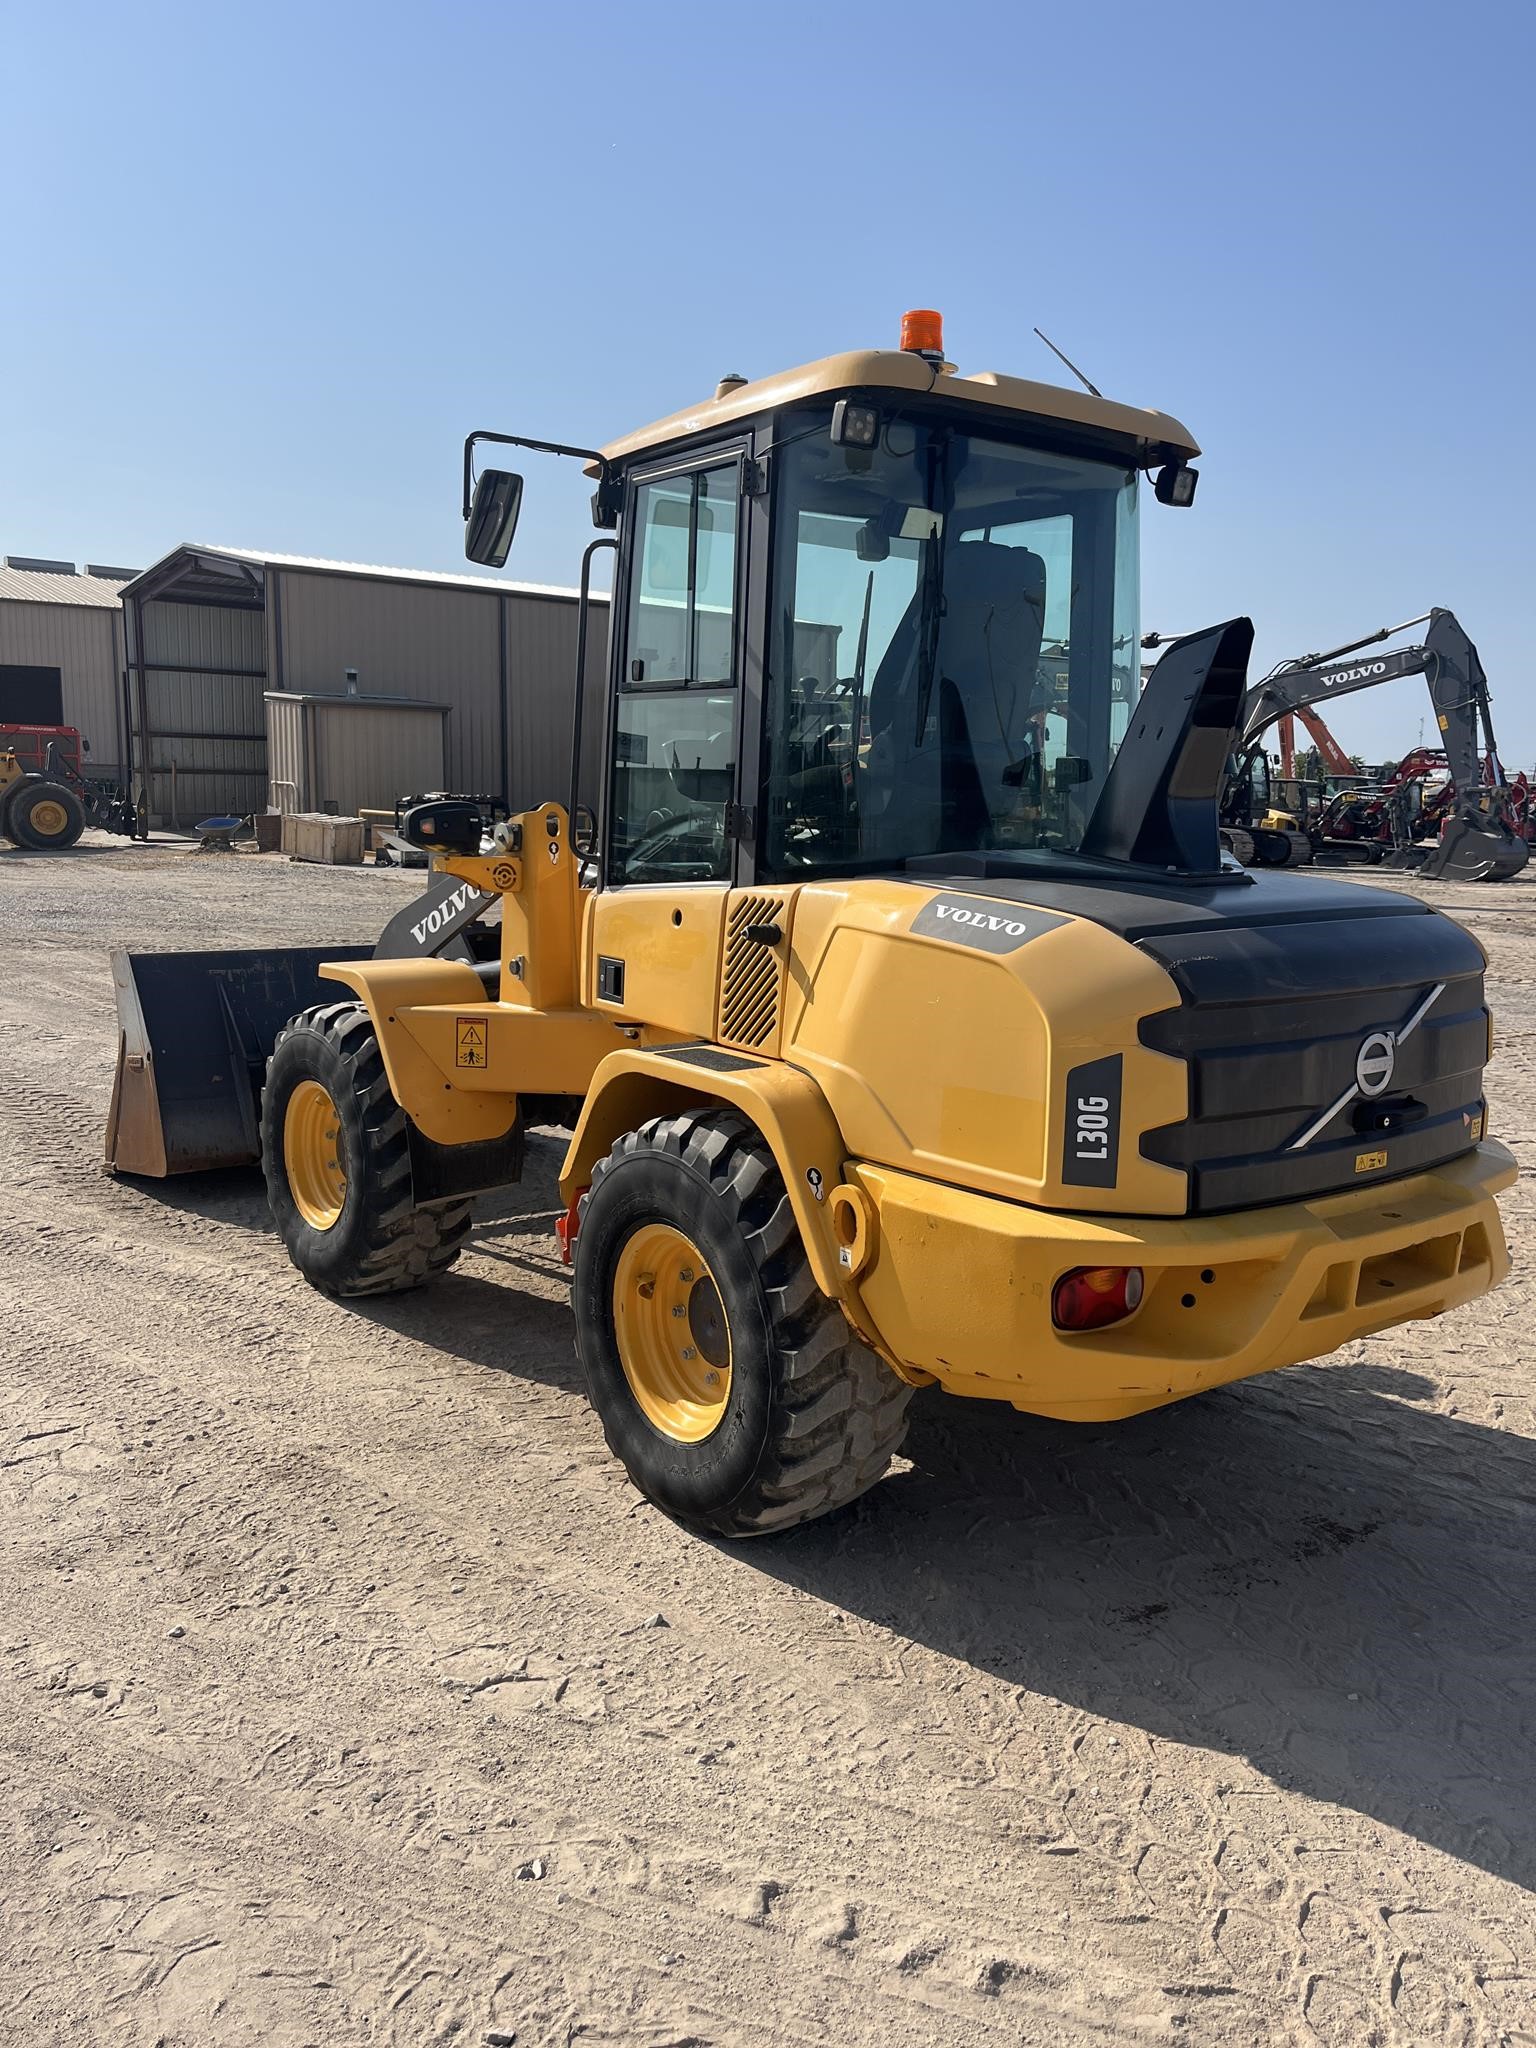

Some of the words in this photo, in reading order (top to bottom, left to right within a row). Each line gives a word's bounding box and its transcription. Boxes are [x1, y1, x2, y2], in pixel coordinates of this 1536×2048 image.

[1320, 662, 1386, 687] VOLVO
[936, 904, 1026, 936] VOLVO
[1076, 1096, 1109, 1159] L30G
